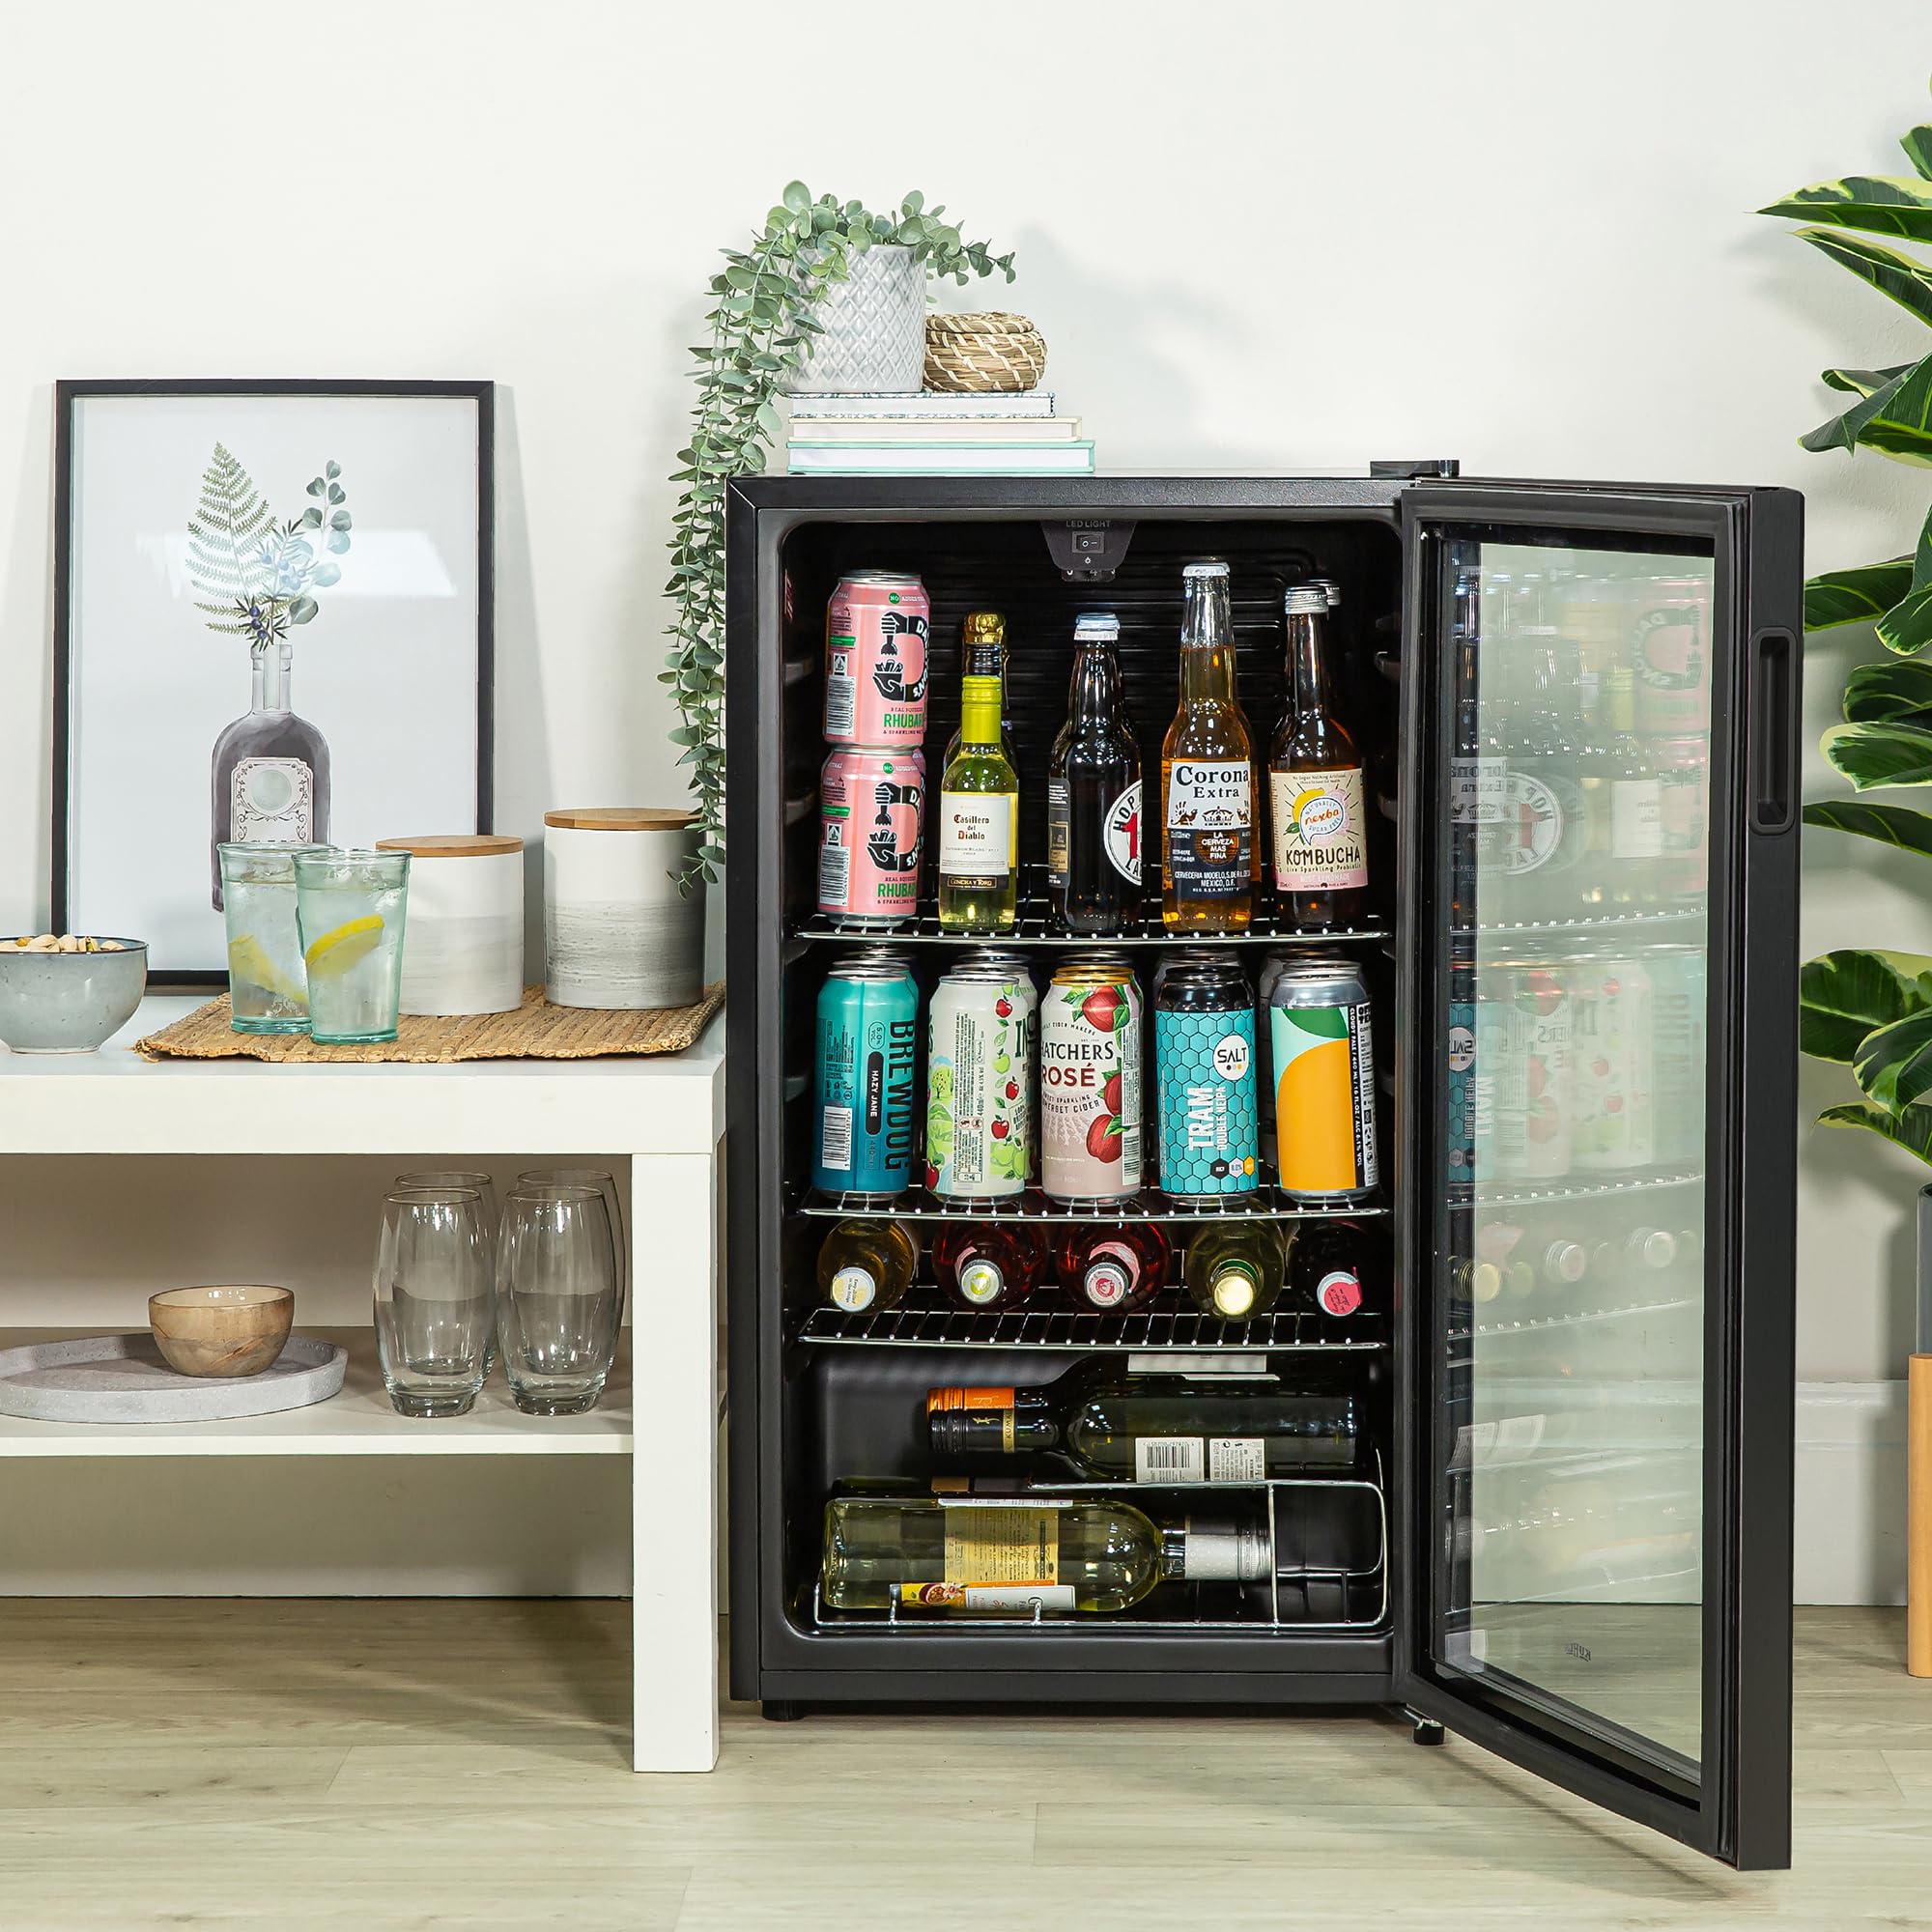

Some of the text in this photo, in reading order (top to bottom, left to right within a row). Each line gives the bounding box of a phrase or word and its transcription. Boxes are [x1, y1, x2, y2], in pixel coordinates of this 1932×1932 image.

[883, 713, 924, 728] RHUBAR
[1176, 765, 1249, 786] Corona
[1193, 786, 1239, 799] Extra
[953, 814, 990, 824] Casillero
[1113, 795, 1135, 832] HOP
[1304, 808, 1340, 826] nexba
[957, 830, 985, 840] Diablo
[1202, 838, 1234, 846] CERVEZA
[1286, 846, 1361, 866] KOMBUCHA
[1217, 1047, 1246, 1064] SALT
[1042, 1063, 1095, 1087] ROSÉ
[1353, 1070, 1358, 1080] ML
[885, 1020, 915, 1171] BREWDOG
[1353, 1086, 1359, 1094] 16
[1057, 1094, 1091, 1103] SPARKLING
[1073, 1099, 1100, 1113] CIDER
[1187, 1087, 1214, 1151] TRAM
[1215, 1087, 1228, 1151] DOUBLE NEIPA
